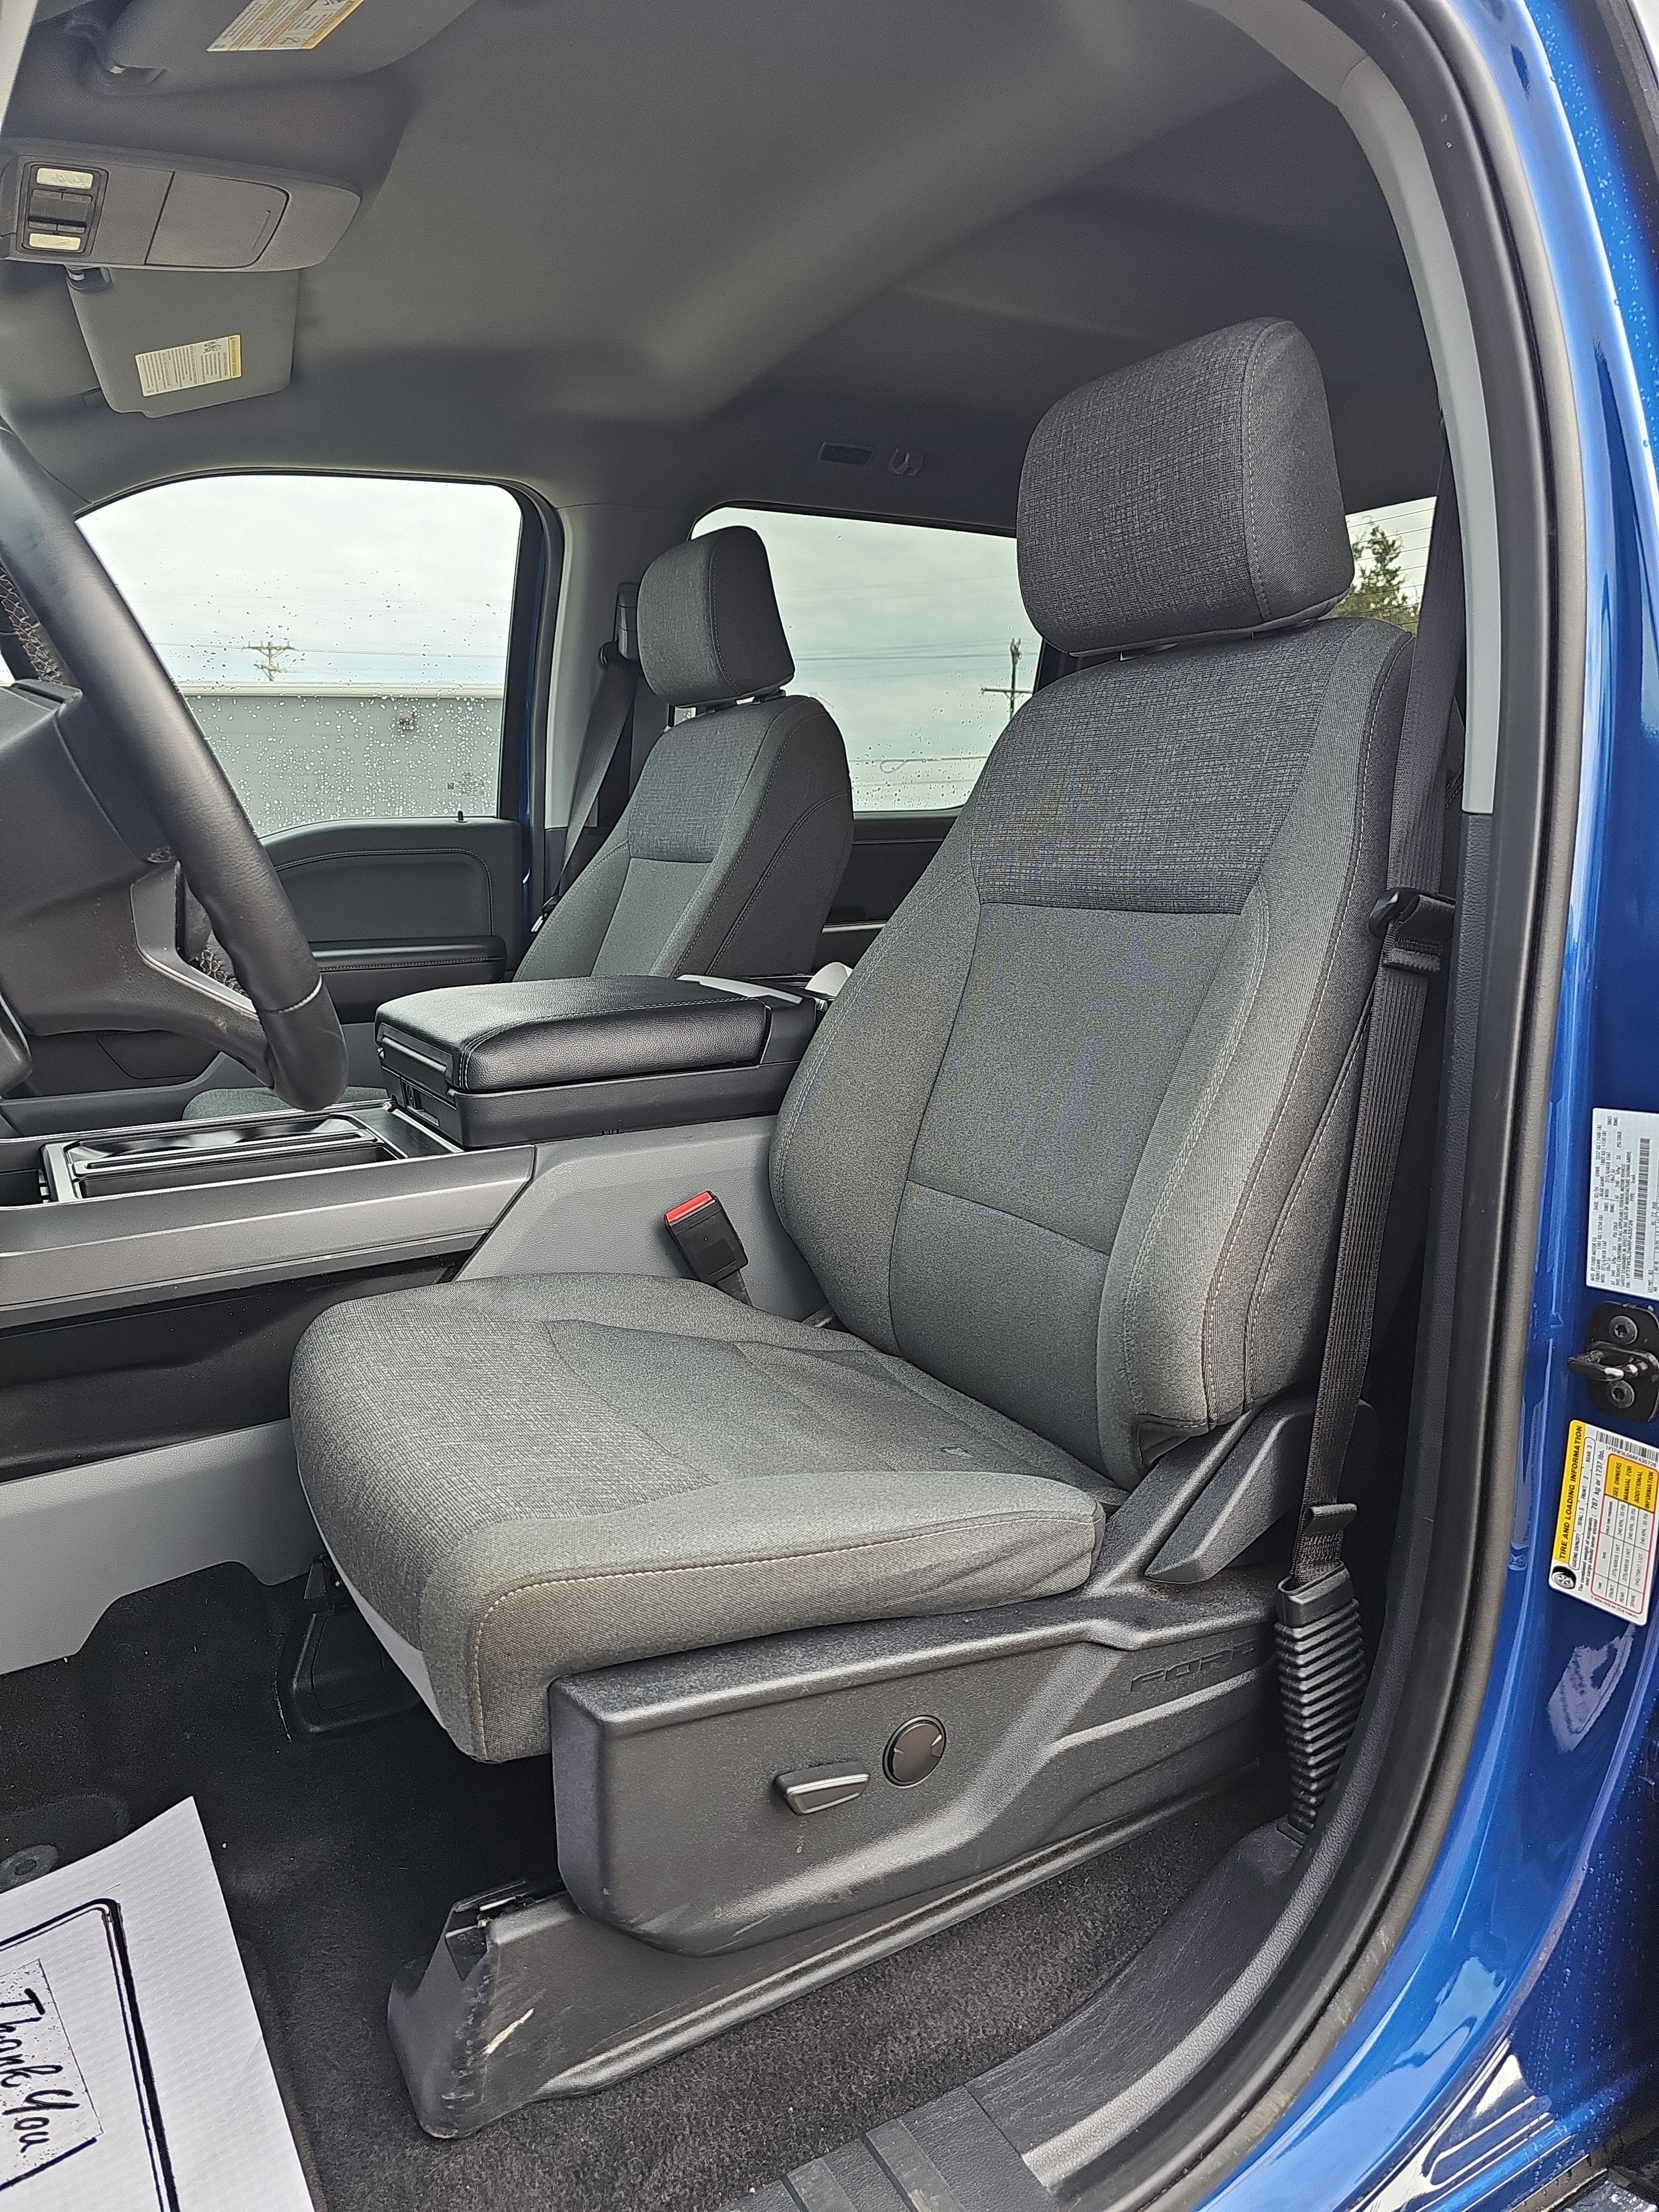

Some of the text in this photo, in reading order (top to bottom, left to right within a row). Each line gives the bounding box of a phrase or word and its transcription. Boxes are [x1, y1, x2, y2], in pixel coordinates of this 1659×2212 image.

[1613, 1462, 1622, 1485] OWNERS
[1623, 1478, 1631, 1501] MANUAL
[1634, 1471, 1643, 1503] ADDITIONAL
[1644, 1471, 1654, 1508] INFORMATION
[1559, 1540, 1567, 1559] TIRE
[1564, 1484, 1575, 1520] LOADING
[1570, 1425, 1582, 1482] INFORMATION
[2, 2089, 81, 2153] You
